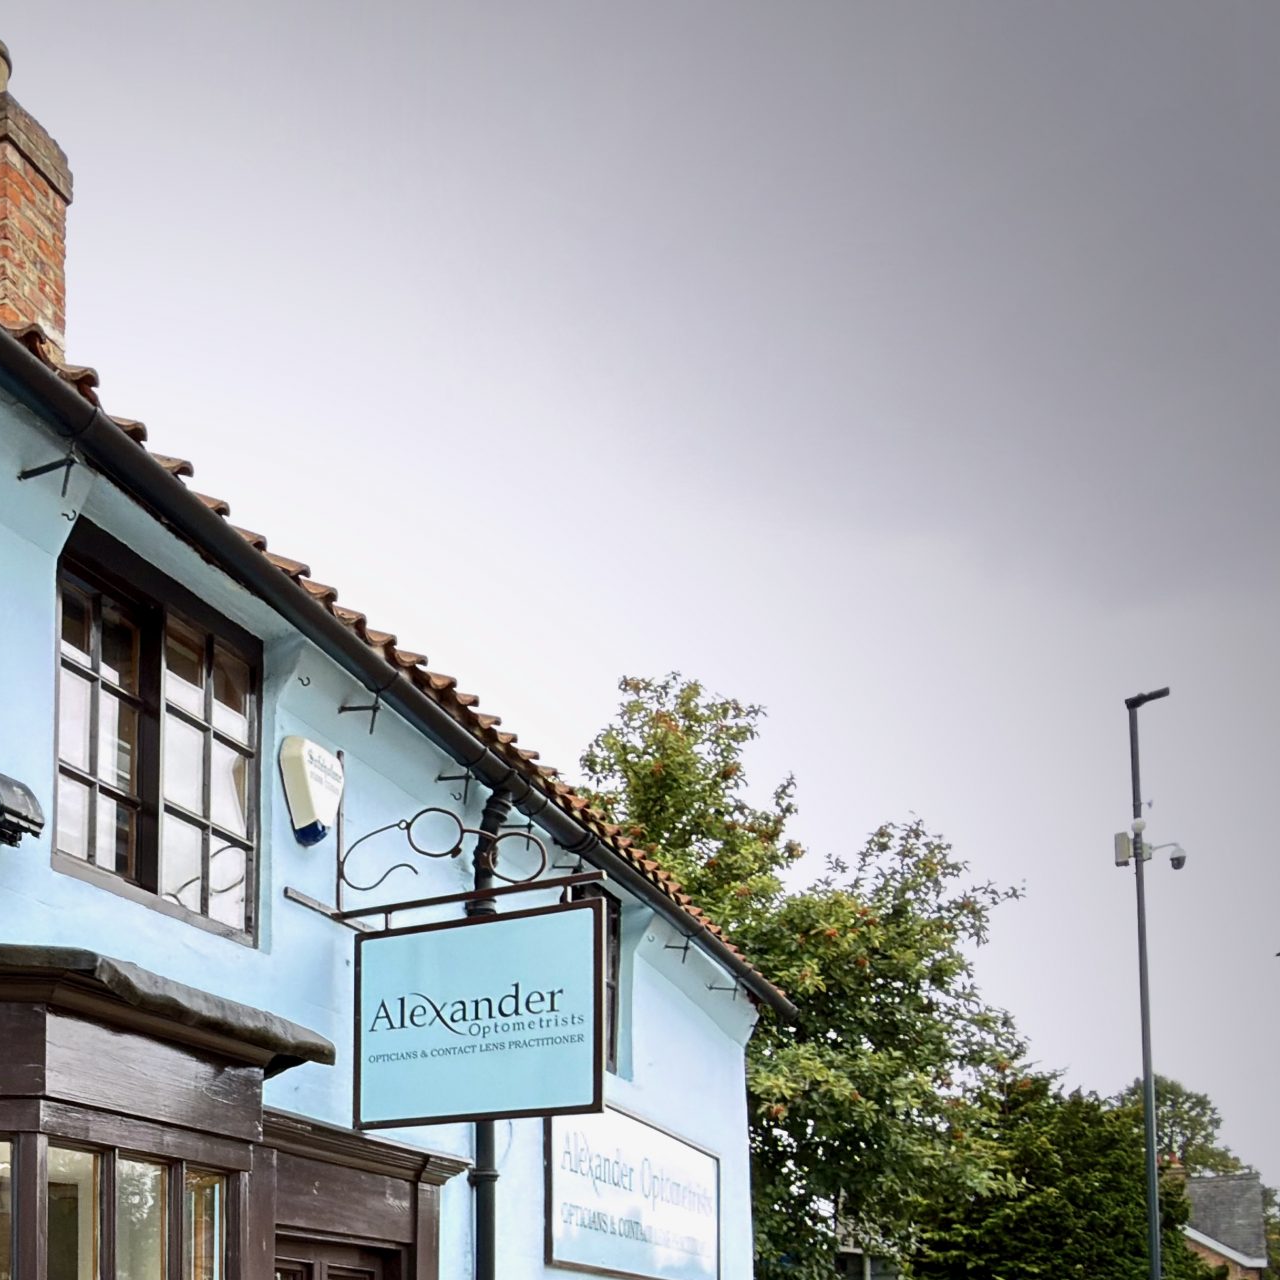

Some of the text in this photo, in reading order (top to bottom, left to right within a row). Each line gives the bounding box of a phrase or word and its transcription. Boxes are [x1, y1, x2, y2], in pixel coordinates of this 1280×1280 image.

[369, 981, 564, 1036] Alexander
[468, 1014, 585, 1038] Optometrists
[368, 1033, 585, 1063] OPTICIANS & CONTACT LENS PRACTITIONER
[561, 1131, 634, 1197] Alexander
